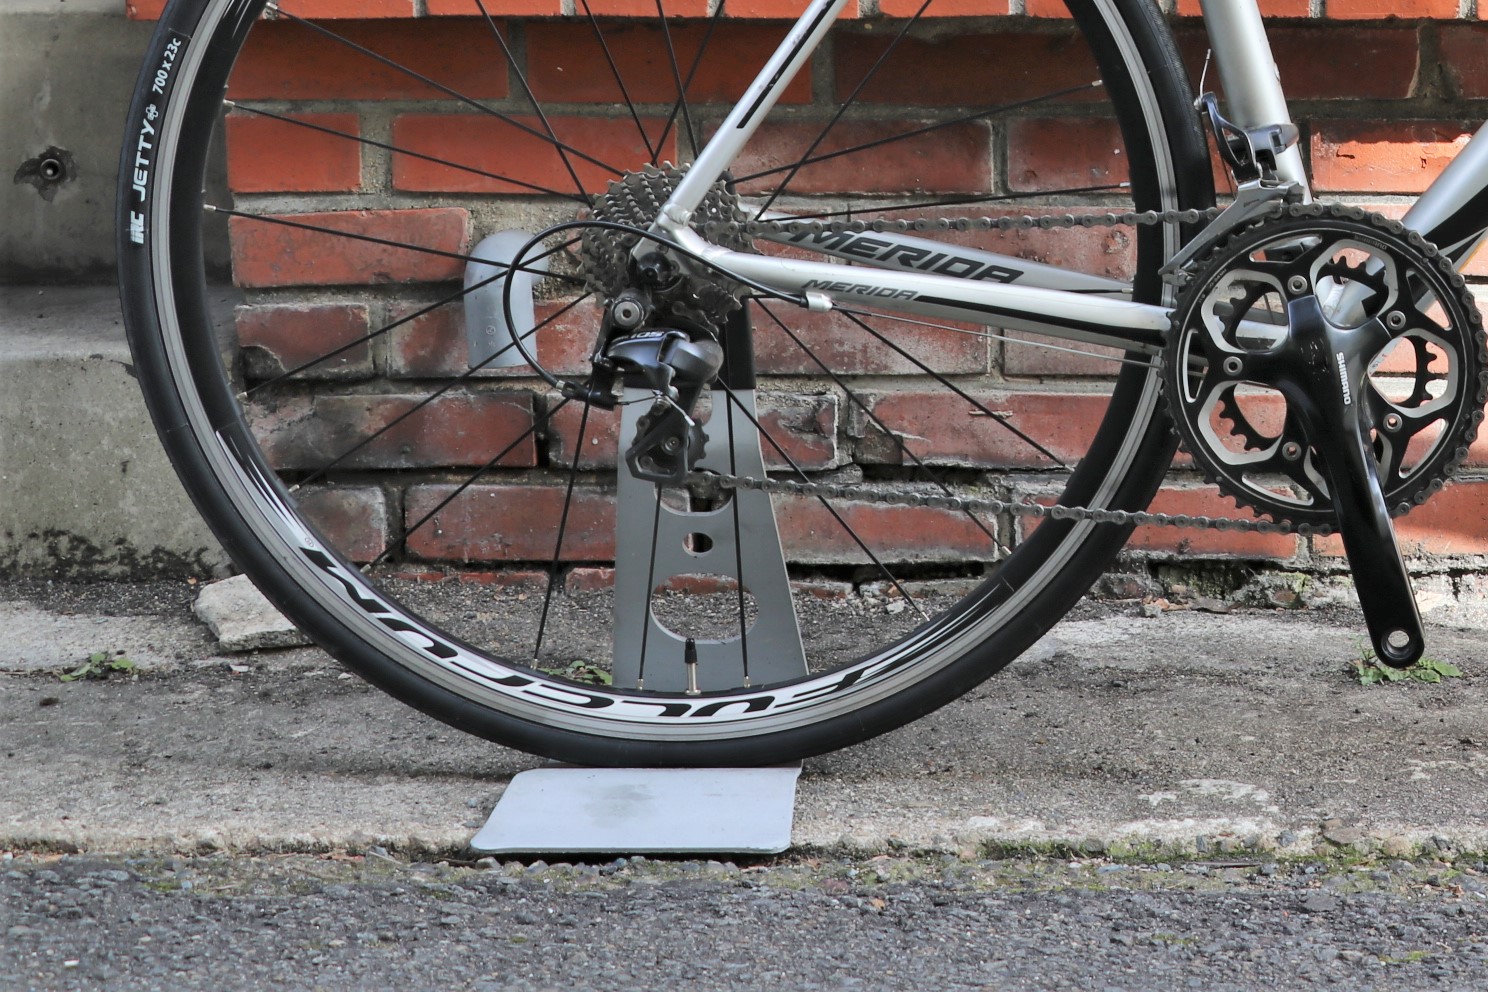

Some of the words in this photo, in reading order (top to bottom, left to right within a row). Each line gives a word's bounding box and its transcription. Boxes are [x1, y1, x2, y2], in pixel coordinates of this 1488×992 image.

[132, 118, 156, 202] JETTY
[788, 230, 1025, 285] MERIDA
[801, 279, 920, 301] MERIDA
[1336, 352, 1352, 405] SHIMANO
[299, 547, 868, 719] FULCRUM
